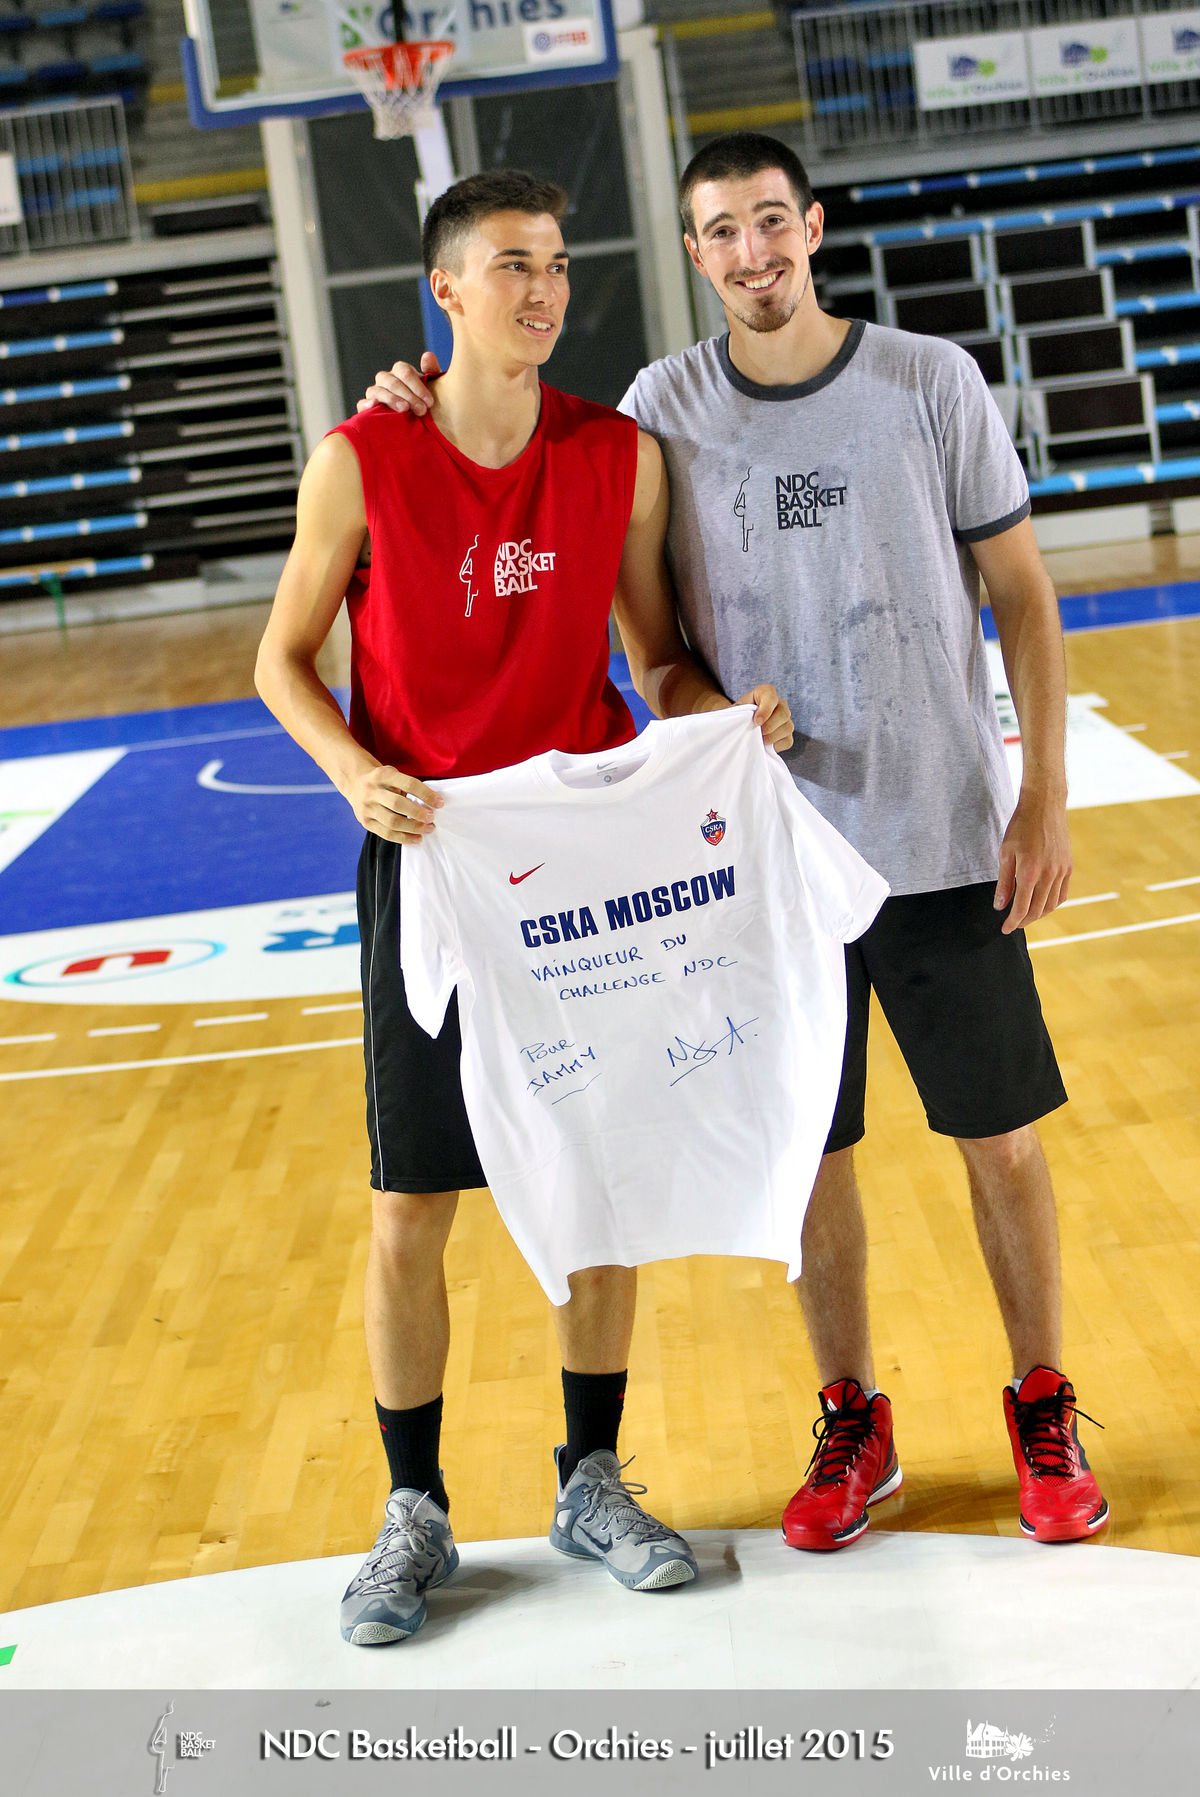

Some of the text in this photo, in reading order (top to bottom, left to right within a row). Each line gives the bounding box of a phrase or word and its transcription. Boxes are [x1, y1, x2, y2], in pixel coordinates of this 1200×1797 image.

[776, 471, 819, 493] NDC
[776, 486, 847, 512] BASKET
[777, 508, 822, 530] BALL
[496, 538, 532, 562] NDC
[494, 552, 556, 579] BASKET
[495, 573, 538, 597] BALL
[520, 866, 736, 948] CSKA MOSCOW
[660, 934, 687, 951] DU
[559, 956, 738, 1001] CHALLENGE NDC
